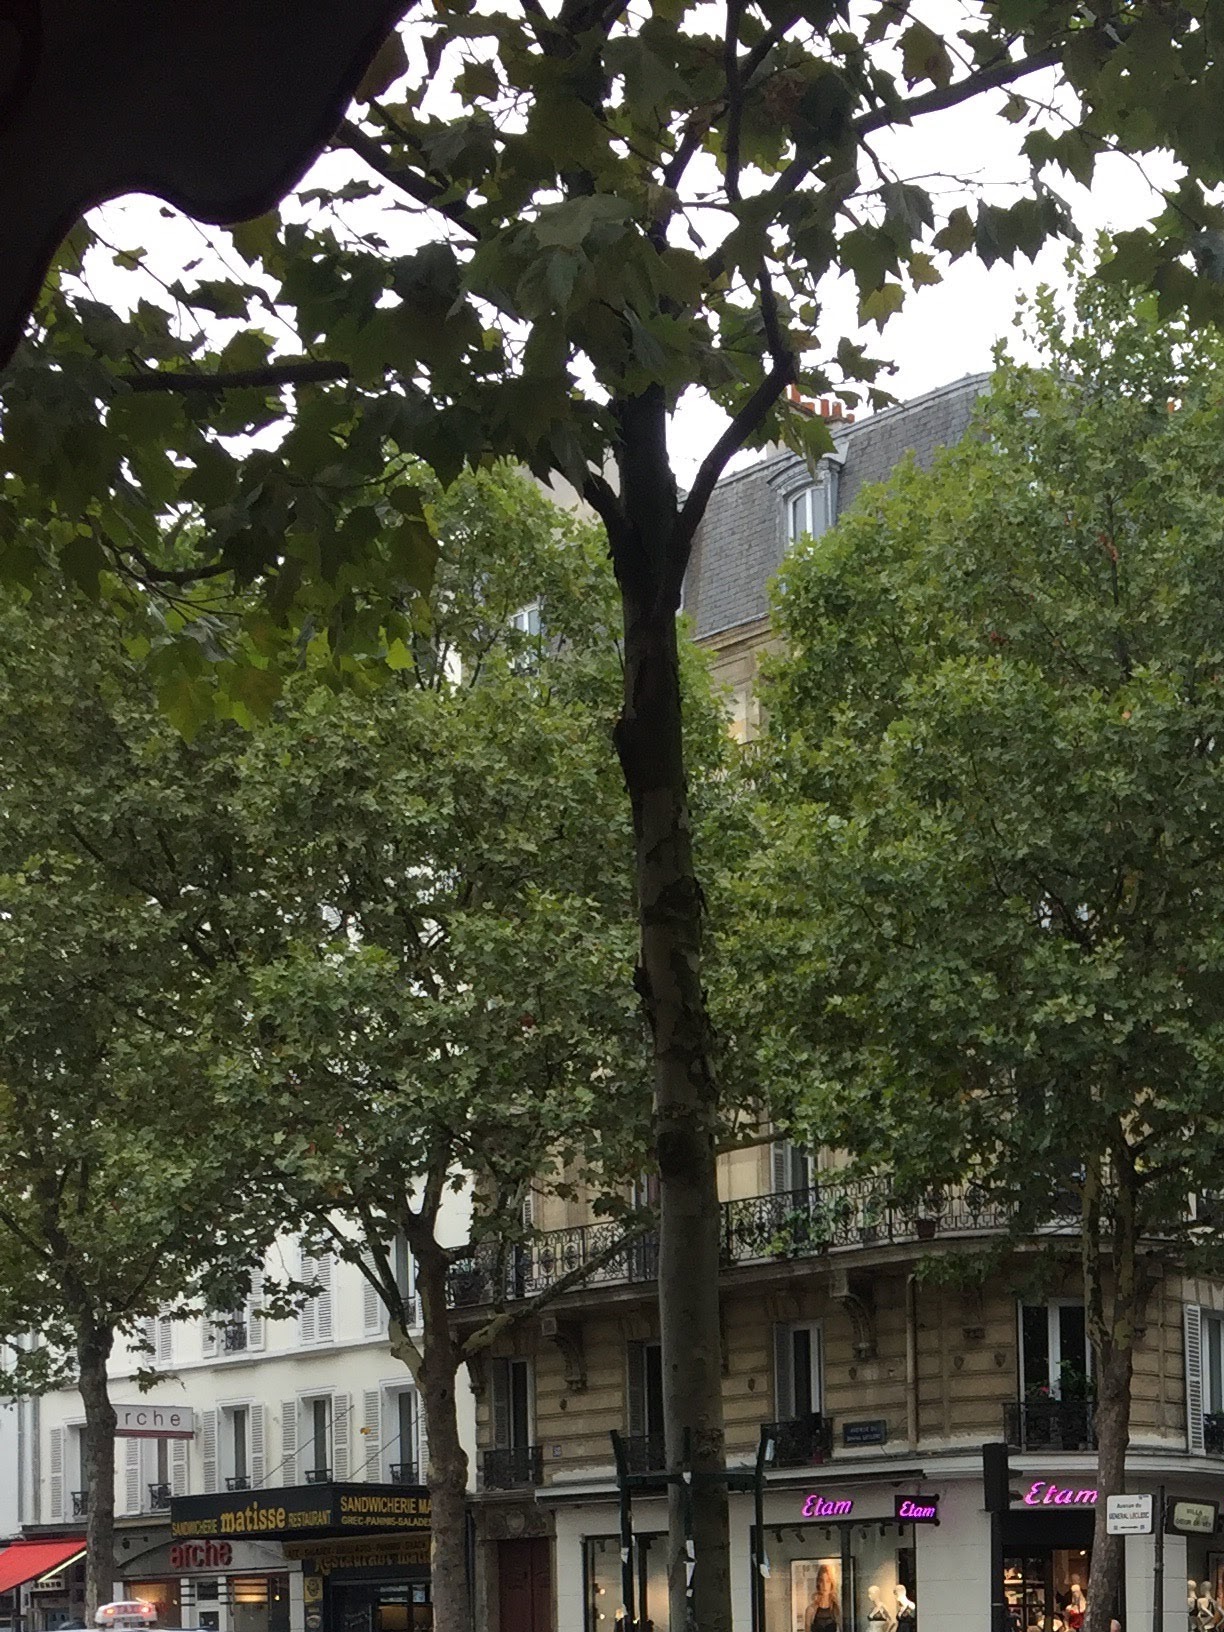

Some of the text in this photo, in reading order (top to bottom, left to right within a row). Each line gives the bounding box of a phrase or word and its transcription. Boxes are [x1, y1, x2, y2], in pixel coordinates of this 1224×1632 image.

[125, 1410, 181, 1426] rche
[1024, 1481, 1098, 1505] Etam
[341, 1496, 417, 1514] SANDWICHERIE
[802, 1494, 853, 1517] Etam
[900, 1501, 935, 1518] Etam
[220, 1501, 286, 1532] matisse
